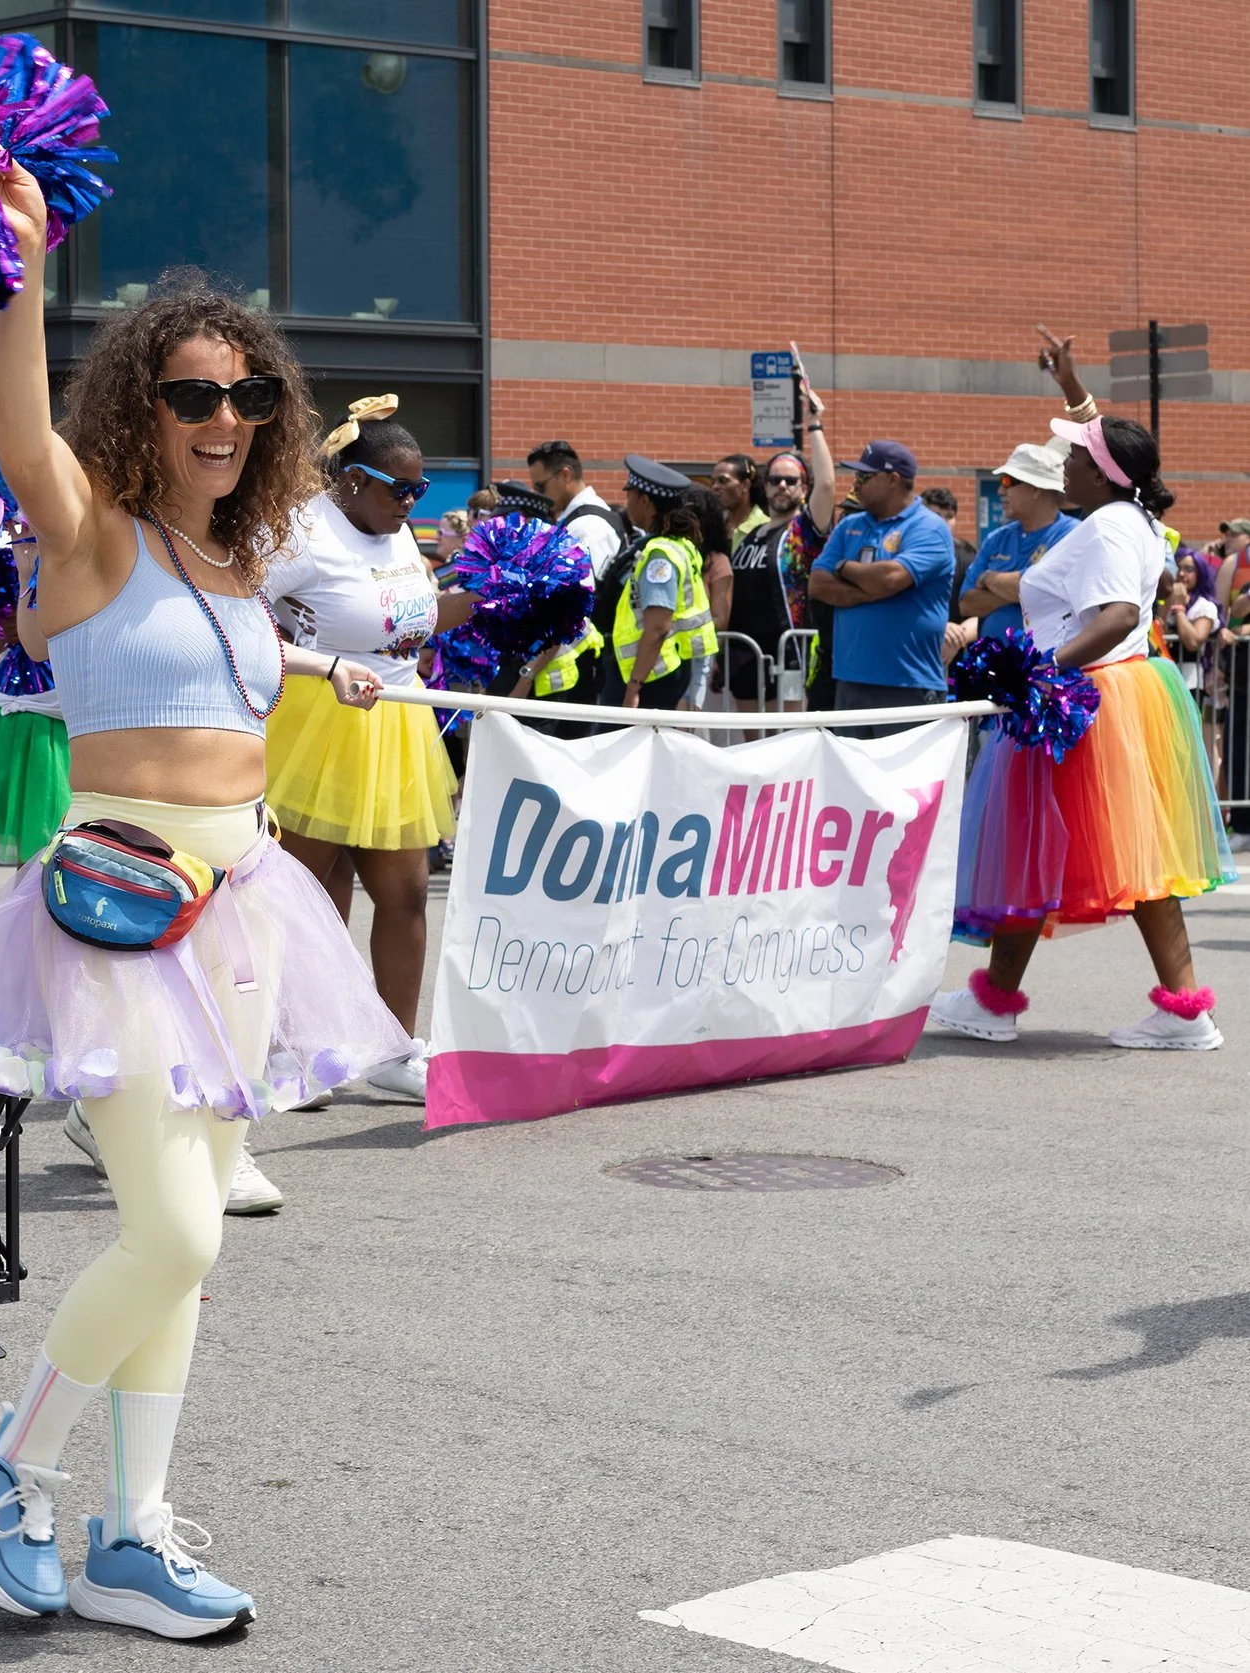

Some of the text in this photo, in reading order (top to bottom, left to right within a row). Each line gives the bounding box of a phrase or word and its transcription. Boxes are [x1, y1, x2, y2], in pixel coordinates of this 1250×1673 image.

[379, 588, 397, 611] GO
[77, 913, 118, 931] cotopaxi
[468, 915, 867, 995] Democrat for Congress
